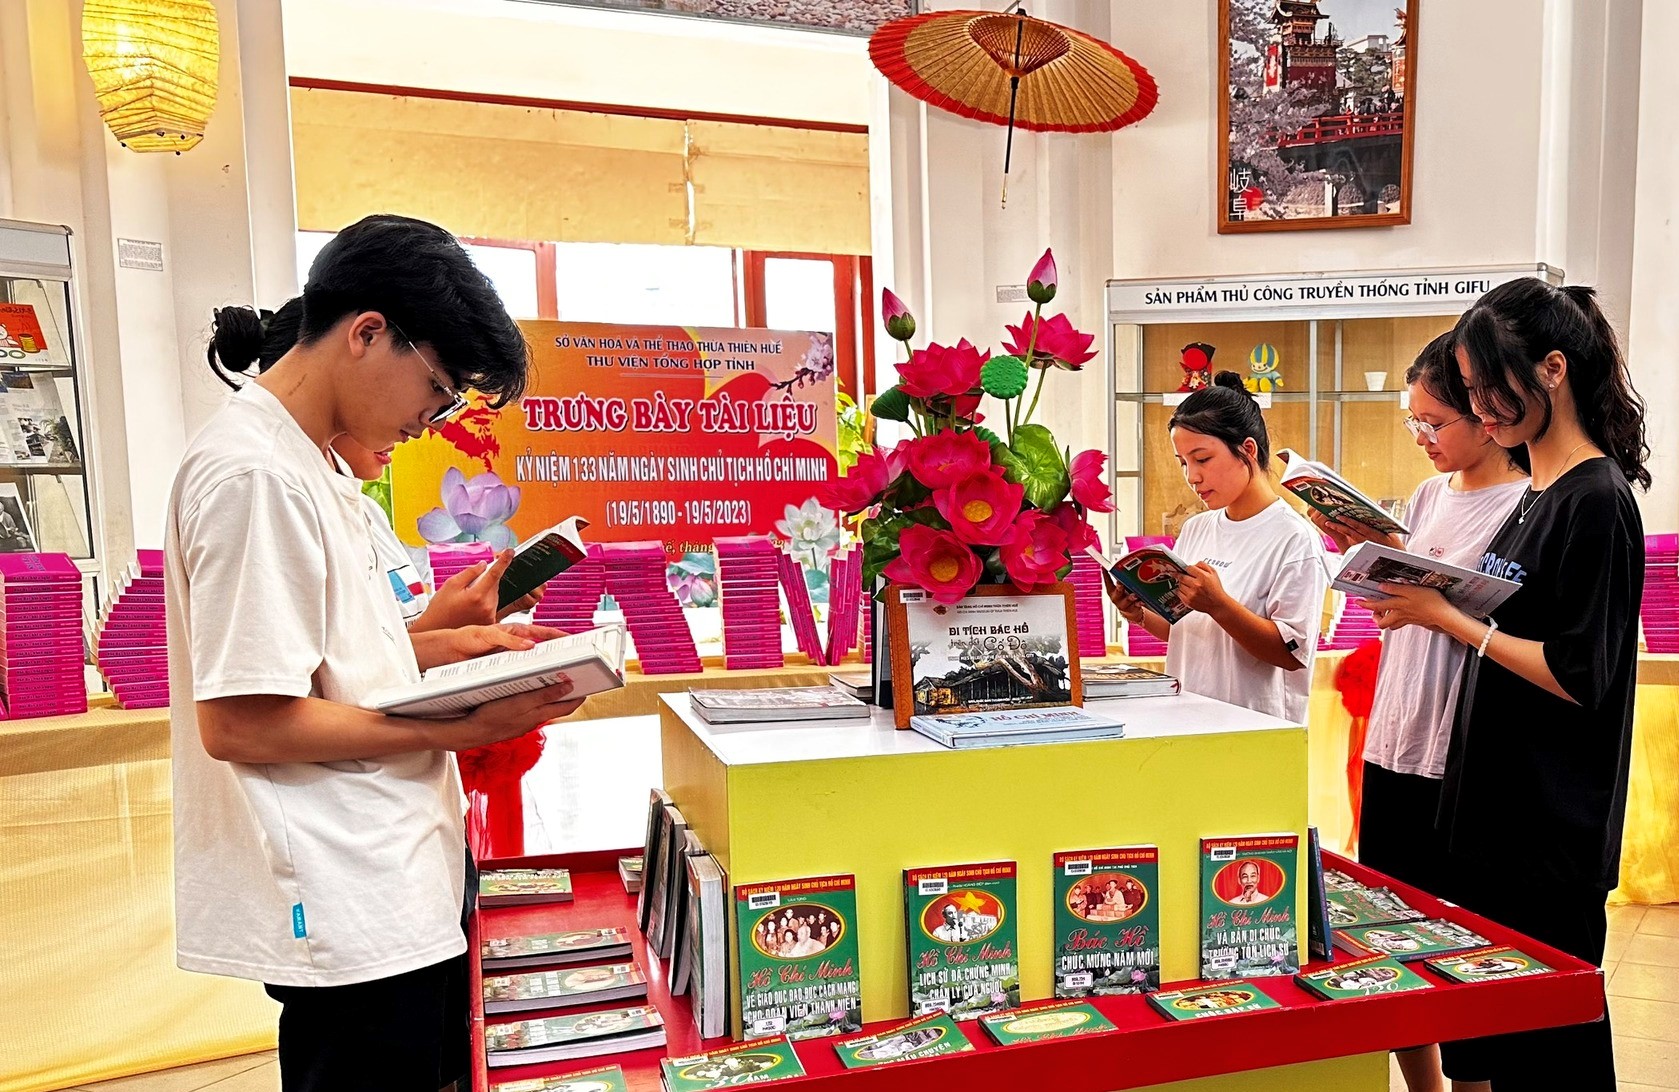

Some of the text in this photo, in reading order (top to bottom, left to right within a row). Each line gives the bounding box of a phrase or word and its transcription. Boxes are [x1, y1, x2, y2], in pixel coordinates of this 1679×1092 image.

[1230, 168, 1251, 220] 岐阜
[1145, 278, 1490, 304] SẢN PHẨM THỦ CÔNG TRUYỀN THỐNG TỈNH GIFU
[555, 334, 570, 348] SỞ
[573, 336, 596, 348] VĂN
[625, 337, 640, 350] VÀ
[643, 335, 663, 350] THỂ
[666, 341, 694, 351] THAO
[697, 340, 725, 352] THỪA
[727, 340, 758, 354] THIÊN
[760, 340, 782, 354] HUẾ
[586, 354, 755, 372] THƯ VIỆN TỔNG HỢP TỈNH
[522, 391, 818, 440] TRƯNG BÀY TÀI LIỆU
[516, 447, 828, 487] KỶ NIỆM 133 NĂM NGÀY SINH CHỦ TỊCH HỒ CHÍ MINH
[962, 625, 986, 636] TÍCH
[990, 624, 1011, 634] BÁC
[1013, 622, 1029, 634] HỒ
[1207, 905, 1290, 929] Hồ Chí Minh
[1065, 925, 1149, 951] Bác Hồ
[916, 940, 1012, 969] Hồ Chí Minh
[1062, 947, 1154, 970] CHÚC MỪNG NĂM MỚI
[748, 958, 852, 988] Hồ Chí Minh
